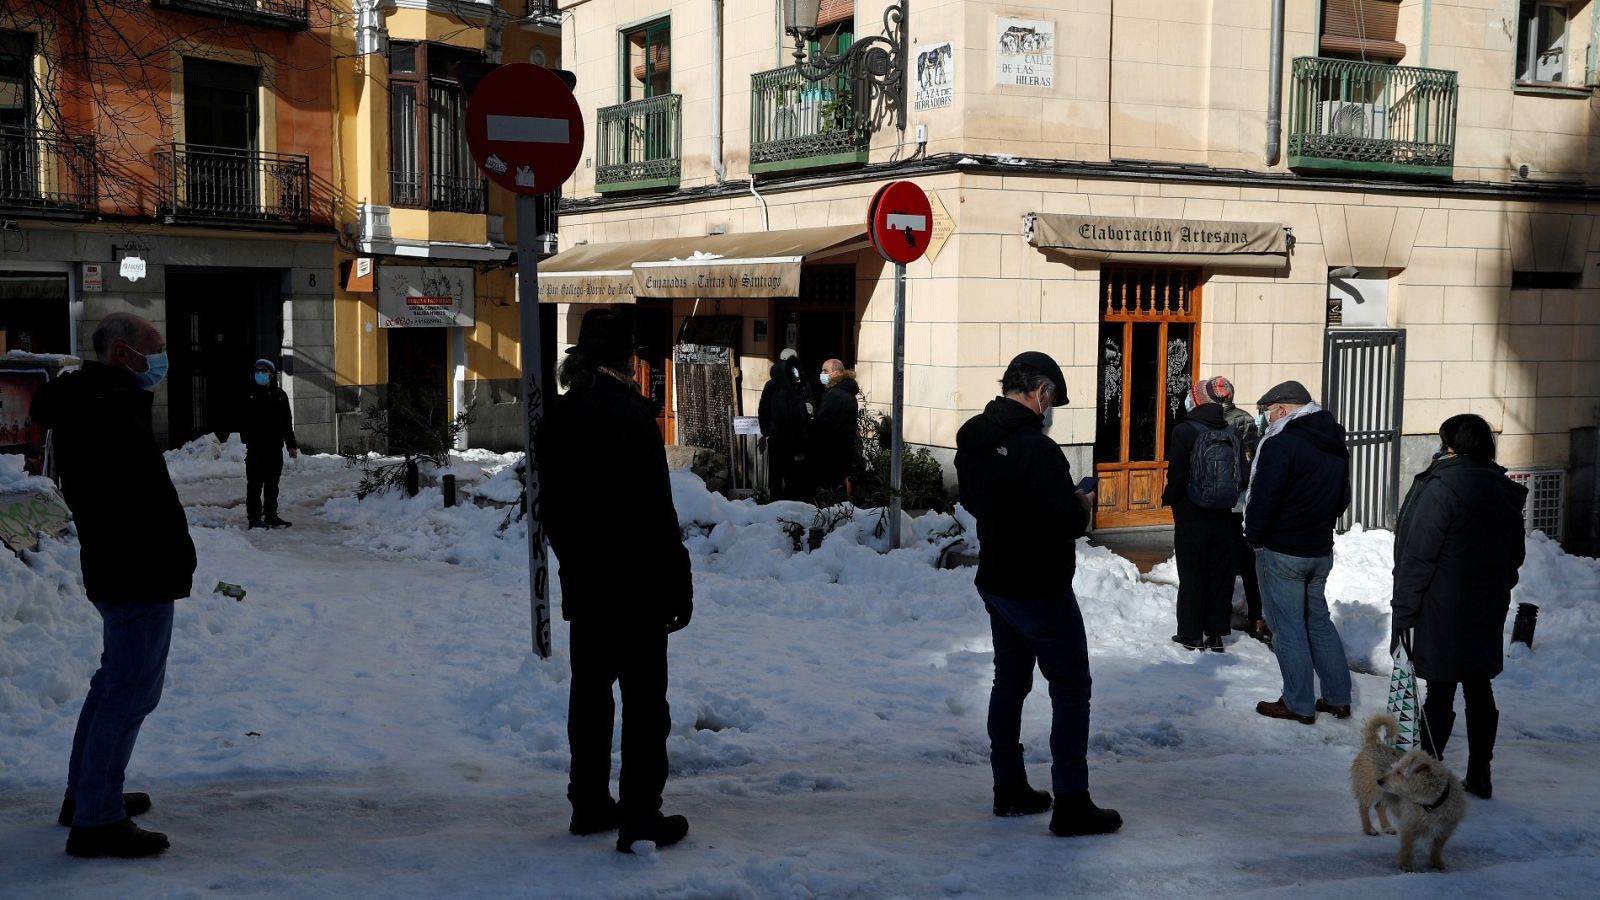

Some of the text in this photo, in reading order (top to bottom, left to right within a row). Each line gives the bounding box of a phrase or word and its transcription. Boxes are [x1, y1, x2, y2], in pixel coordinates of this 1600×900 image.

[1025, 55, 1051, 65] CALLE
[1002, 63, 1033, 74] DE LAS
[1016, 75, 1051, 86] HILERAS
[916, 87, 952, 100] PLAZA DE
[914, 95, 952, 110] HERRADORES
[1078, 223, 1249, 244] Elaboración Artesana
[309, 273, 316, 287] 8
[645, 275, 687, 290] Empanadas
[697, 274, 725, 289] Tartas
[729, 275, 738, 288] de
[741, 273, 782, 290] Santiago
[607, 284, 616, 295] de
